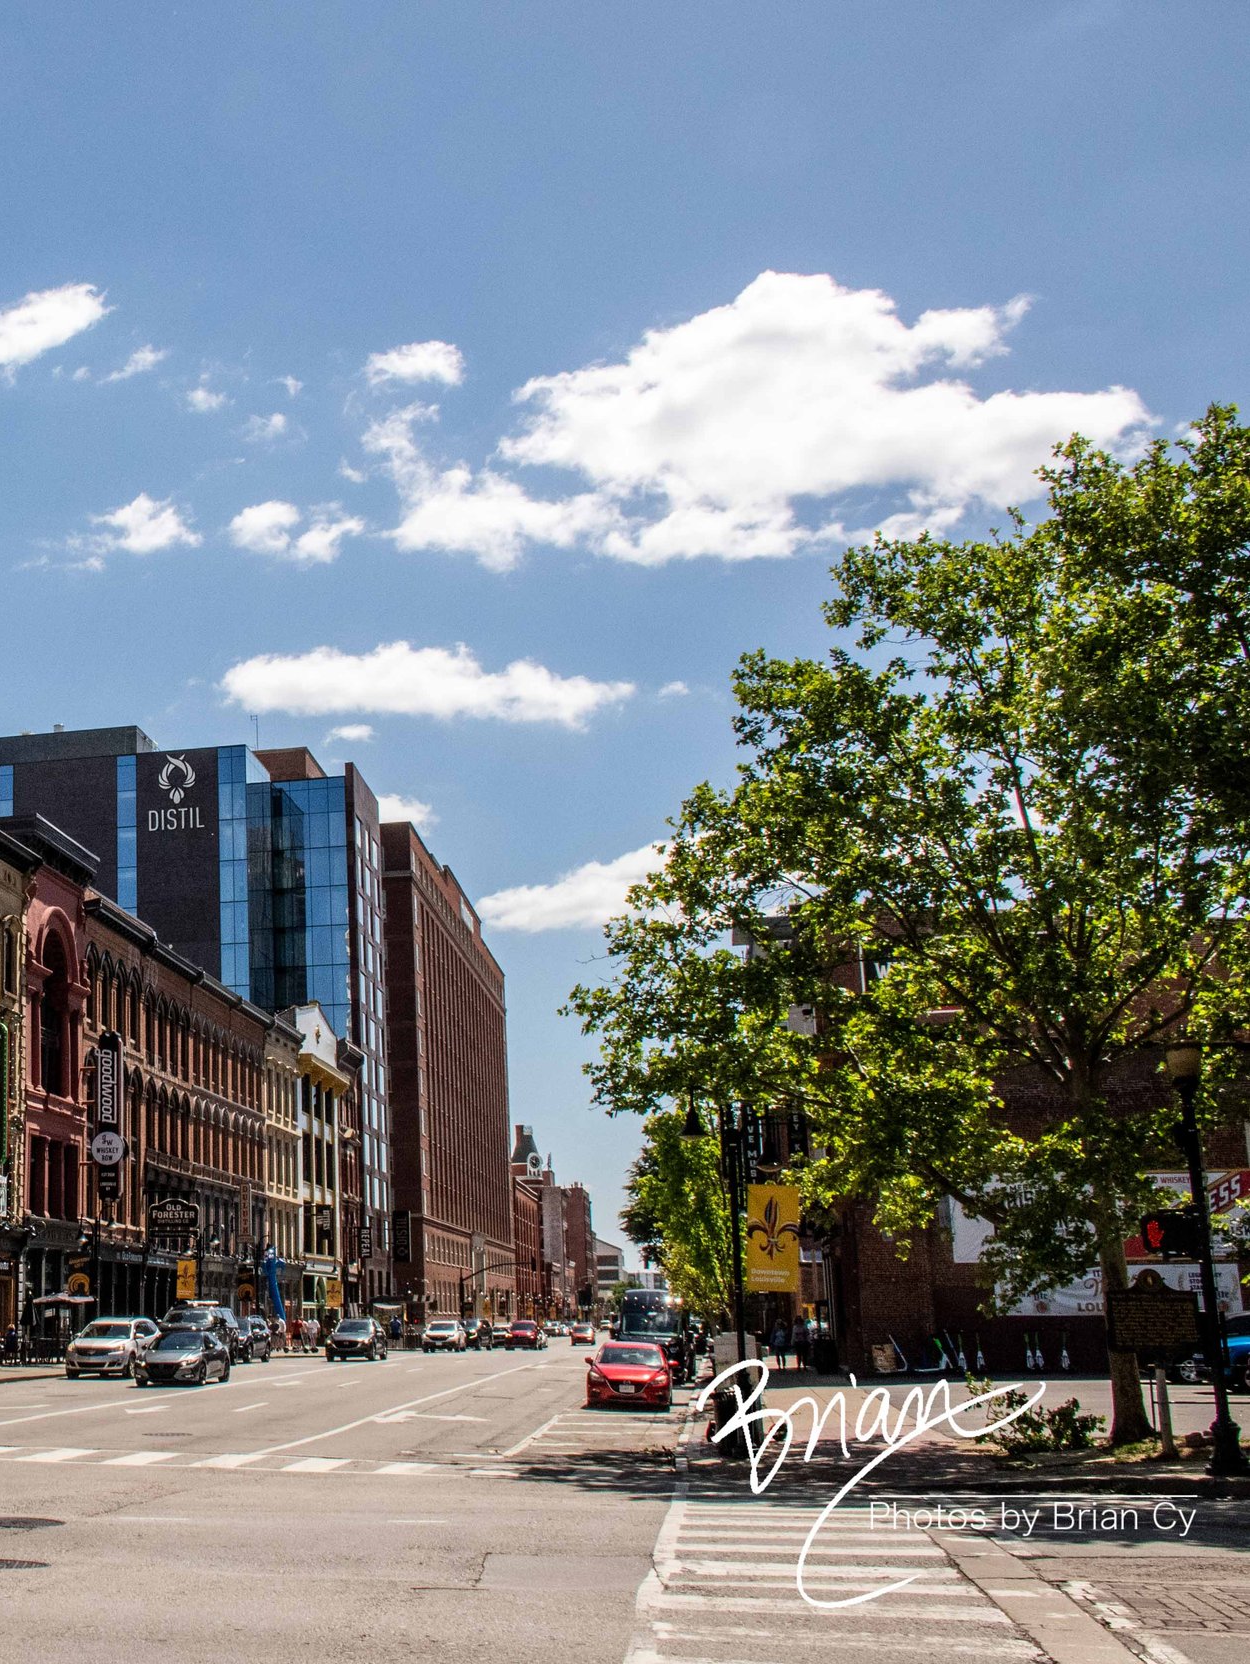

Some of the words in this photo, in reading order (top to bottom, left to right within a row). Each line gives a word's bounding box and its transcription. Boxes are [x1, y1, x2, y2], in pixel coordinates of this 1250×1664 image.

[148, 807, 205, 831] DISTIL
[94, 1048, 118, 1124] goodwood
[746, 1106, 755, 1143] LIVE
[747, 1150, 758, 1184] MUSI
[1160, 1176, 1191, 1184] WHISKEY
[152, 1210, 195, 1219] FORESTER
[361, 1229, 371, 1257] REPEAL
[396, 1217, 408, 1245] DISTIL
